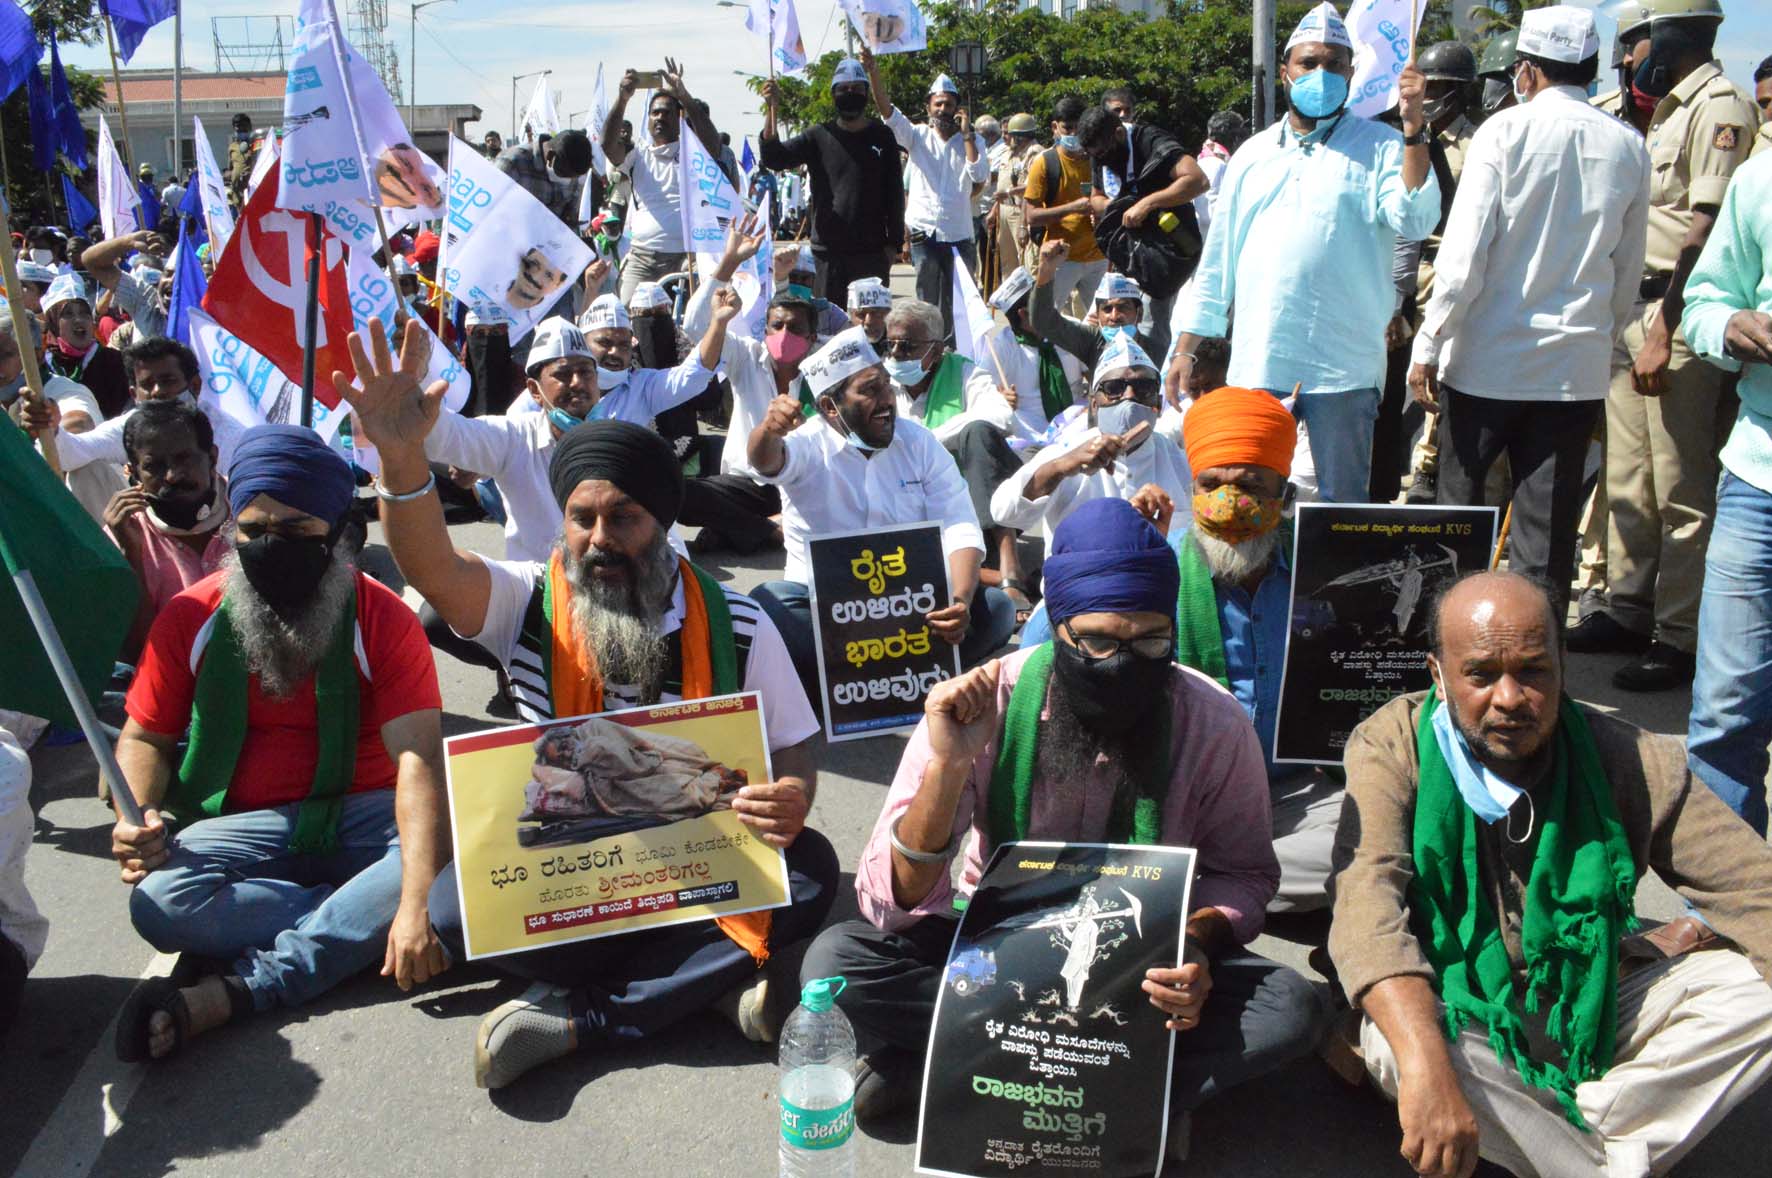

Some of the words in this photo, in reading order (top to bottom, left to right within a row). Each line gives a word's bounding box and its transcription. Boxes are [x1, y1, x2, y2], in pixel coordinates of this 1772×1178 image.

[1446, 523, 1472, 535] KVS
[851, 545, 907, 595] ರೈತ
[831, 583, 936, 624] ಉಳಿದರೆ
[845, 625, 931, 668] ಭಾರತ
[649, 702, 700, 719] ಕರ್ನಾಟಕ
[490, 863, 528, 889] ಭೂ
[541, 846, 624, 879] ರಹಿತರಿಗೆ
[539, 884, 591, 905] ಹೊರತು
[597, 861, 712, 900] ಶ್ರೀಮಂತರಿಗಲ್ಲ
[1132, 865, 1162, 881] KVS
[985, 1020, 1004, 1040] ರೈತ
[1008, 1026, 1050, 1044] ವಿರೋಧಿ
[1055, 1033, 1131, 1059] ಮಸೂದೆಗಳನ್ನು
[1029, 1060, 1078, 1079] ಒತ್ತಾಯಿಸಿ
[1043, 1047, 1111, 1066] ಪಡೆಯುವಂತೆ
[972, 1073, 1085, 1108] ರಾಜಭವನ
[1022, 1108, 1107, 1141] ಮುತ್ತಿಗೆ
[983, 1149, 1034, 1169] ವಿದ್ಯಾರ್ಥಿ
[1031, 1139, 1102, 1161] ರೈತರೊಂದಿಗೆ
